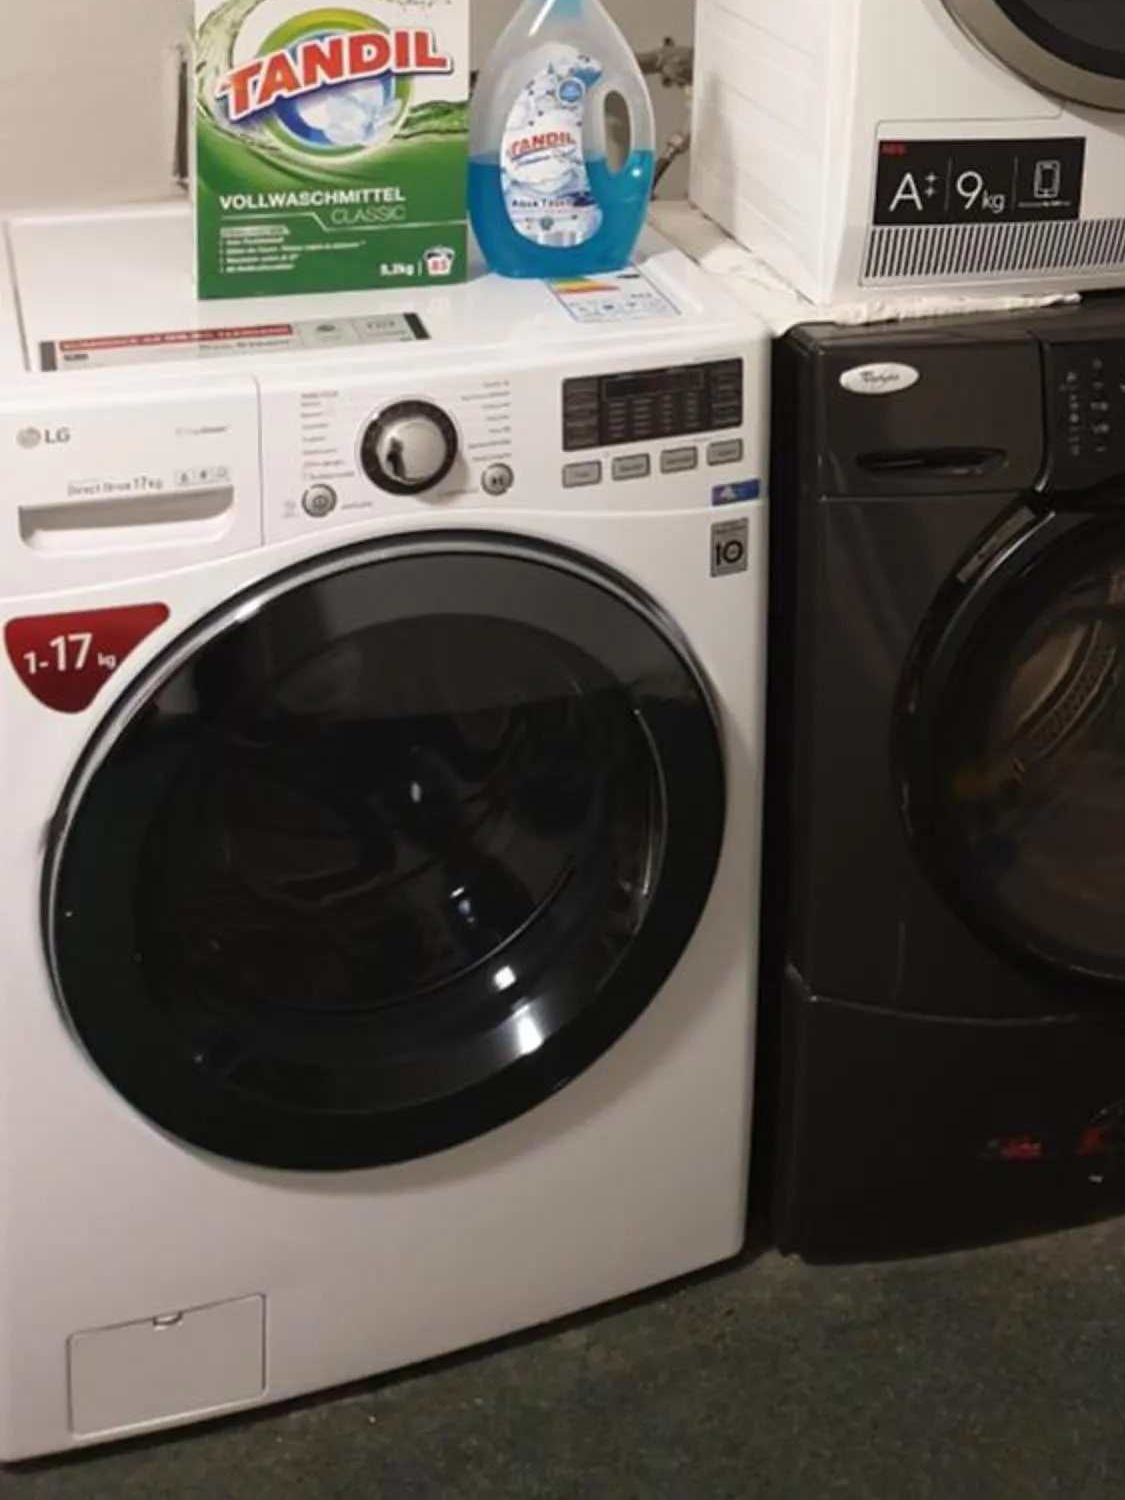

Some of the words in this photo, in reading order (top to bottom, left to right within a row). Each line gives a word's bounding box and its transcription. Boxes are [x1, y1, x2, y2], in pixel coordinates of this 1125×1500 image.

[216, 30, 449, 116] TANDIL
[510, 131, 576, 156] TANDIL
[219, 187, 407, 211] VOLLWASCHMITTEL
[330, 205, 407, 224] CLASSIC
[44, 428, 70, 444] LG
